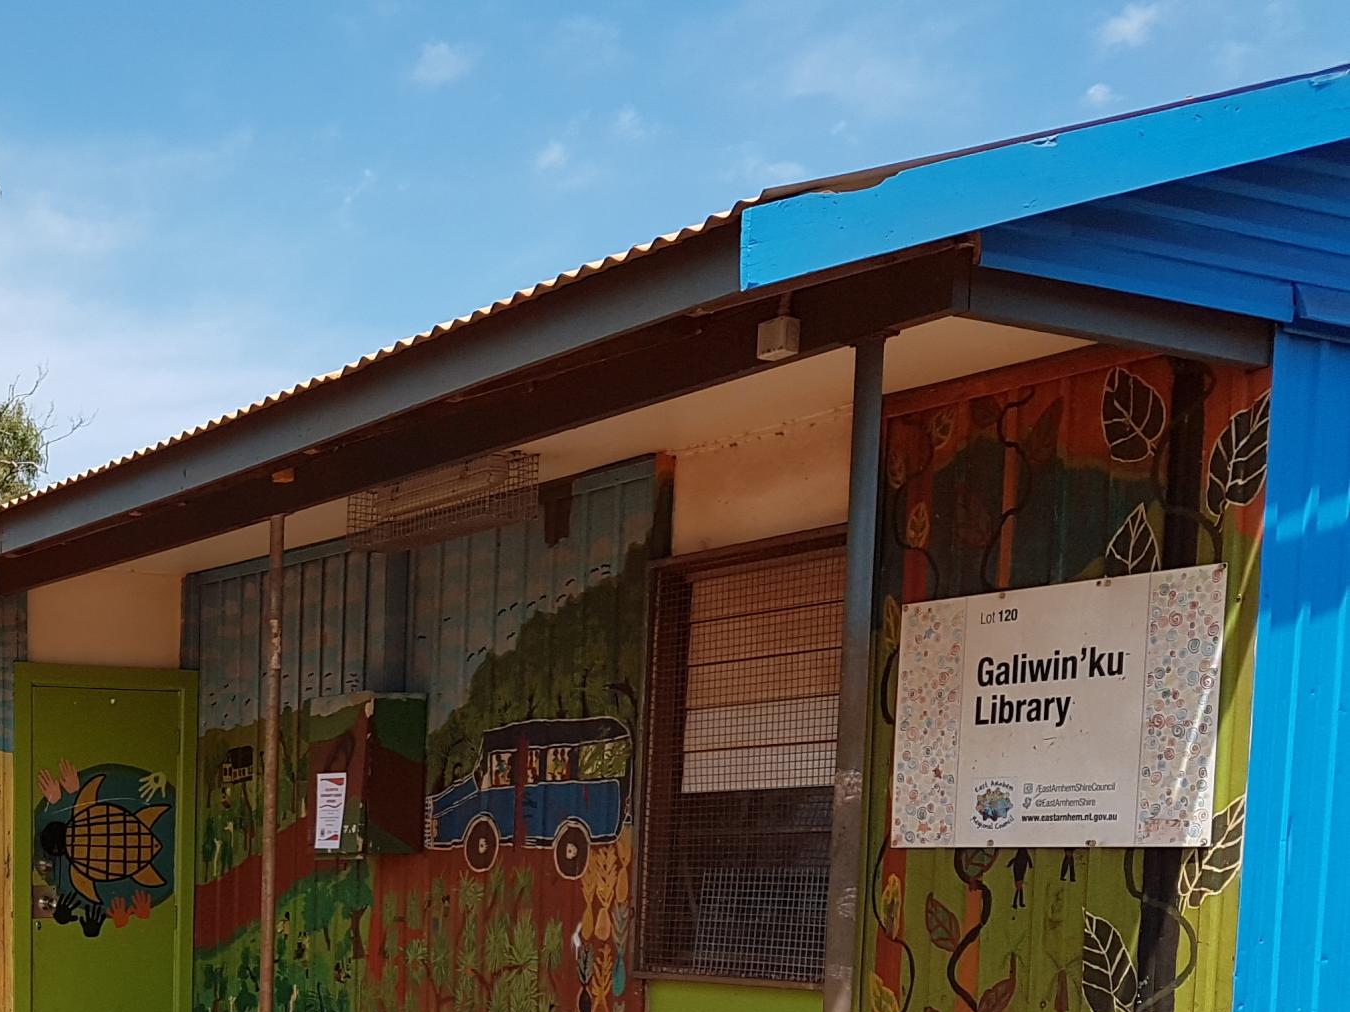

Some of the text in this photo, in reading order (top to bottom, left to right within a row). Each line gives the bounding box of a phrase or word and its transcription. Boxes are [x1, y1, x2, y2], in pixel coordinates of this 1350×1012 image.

[980, 608, 1019, 625] Lot 120
[975, 694, 1071, 727] Library
[994, 815, 1015, 830] Council
[1021, 812, 1118, 823] www.eastarnhem.nt.gov.au
